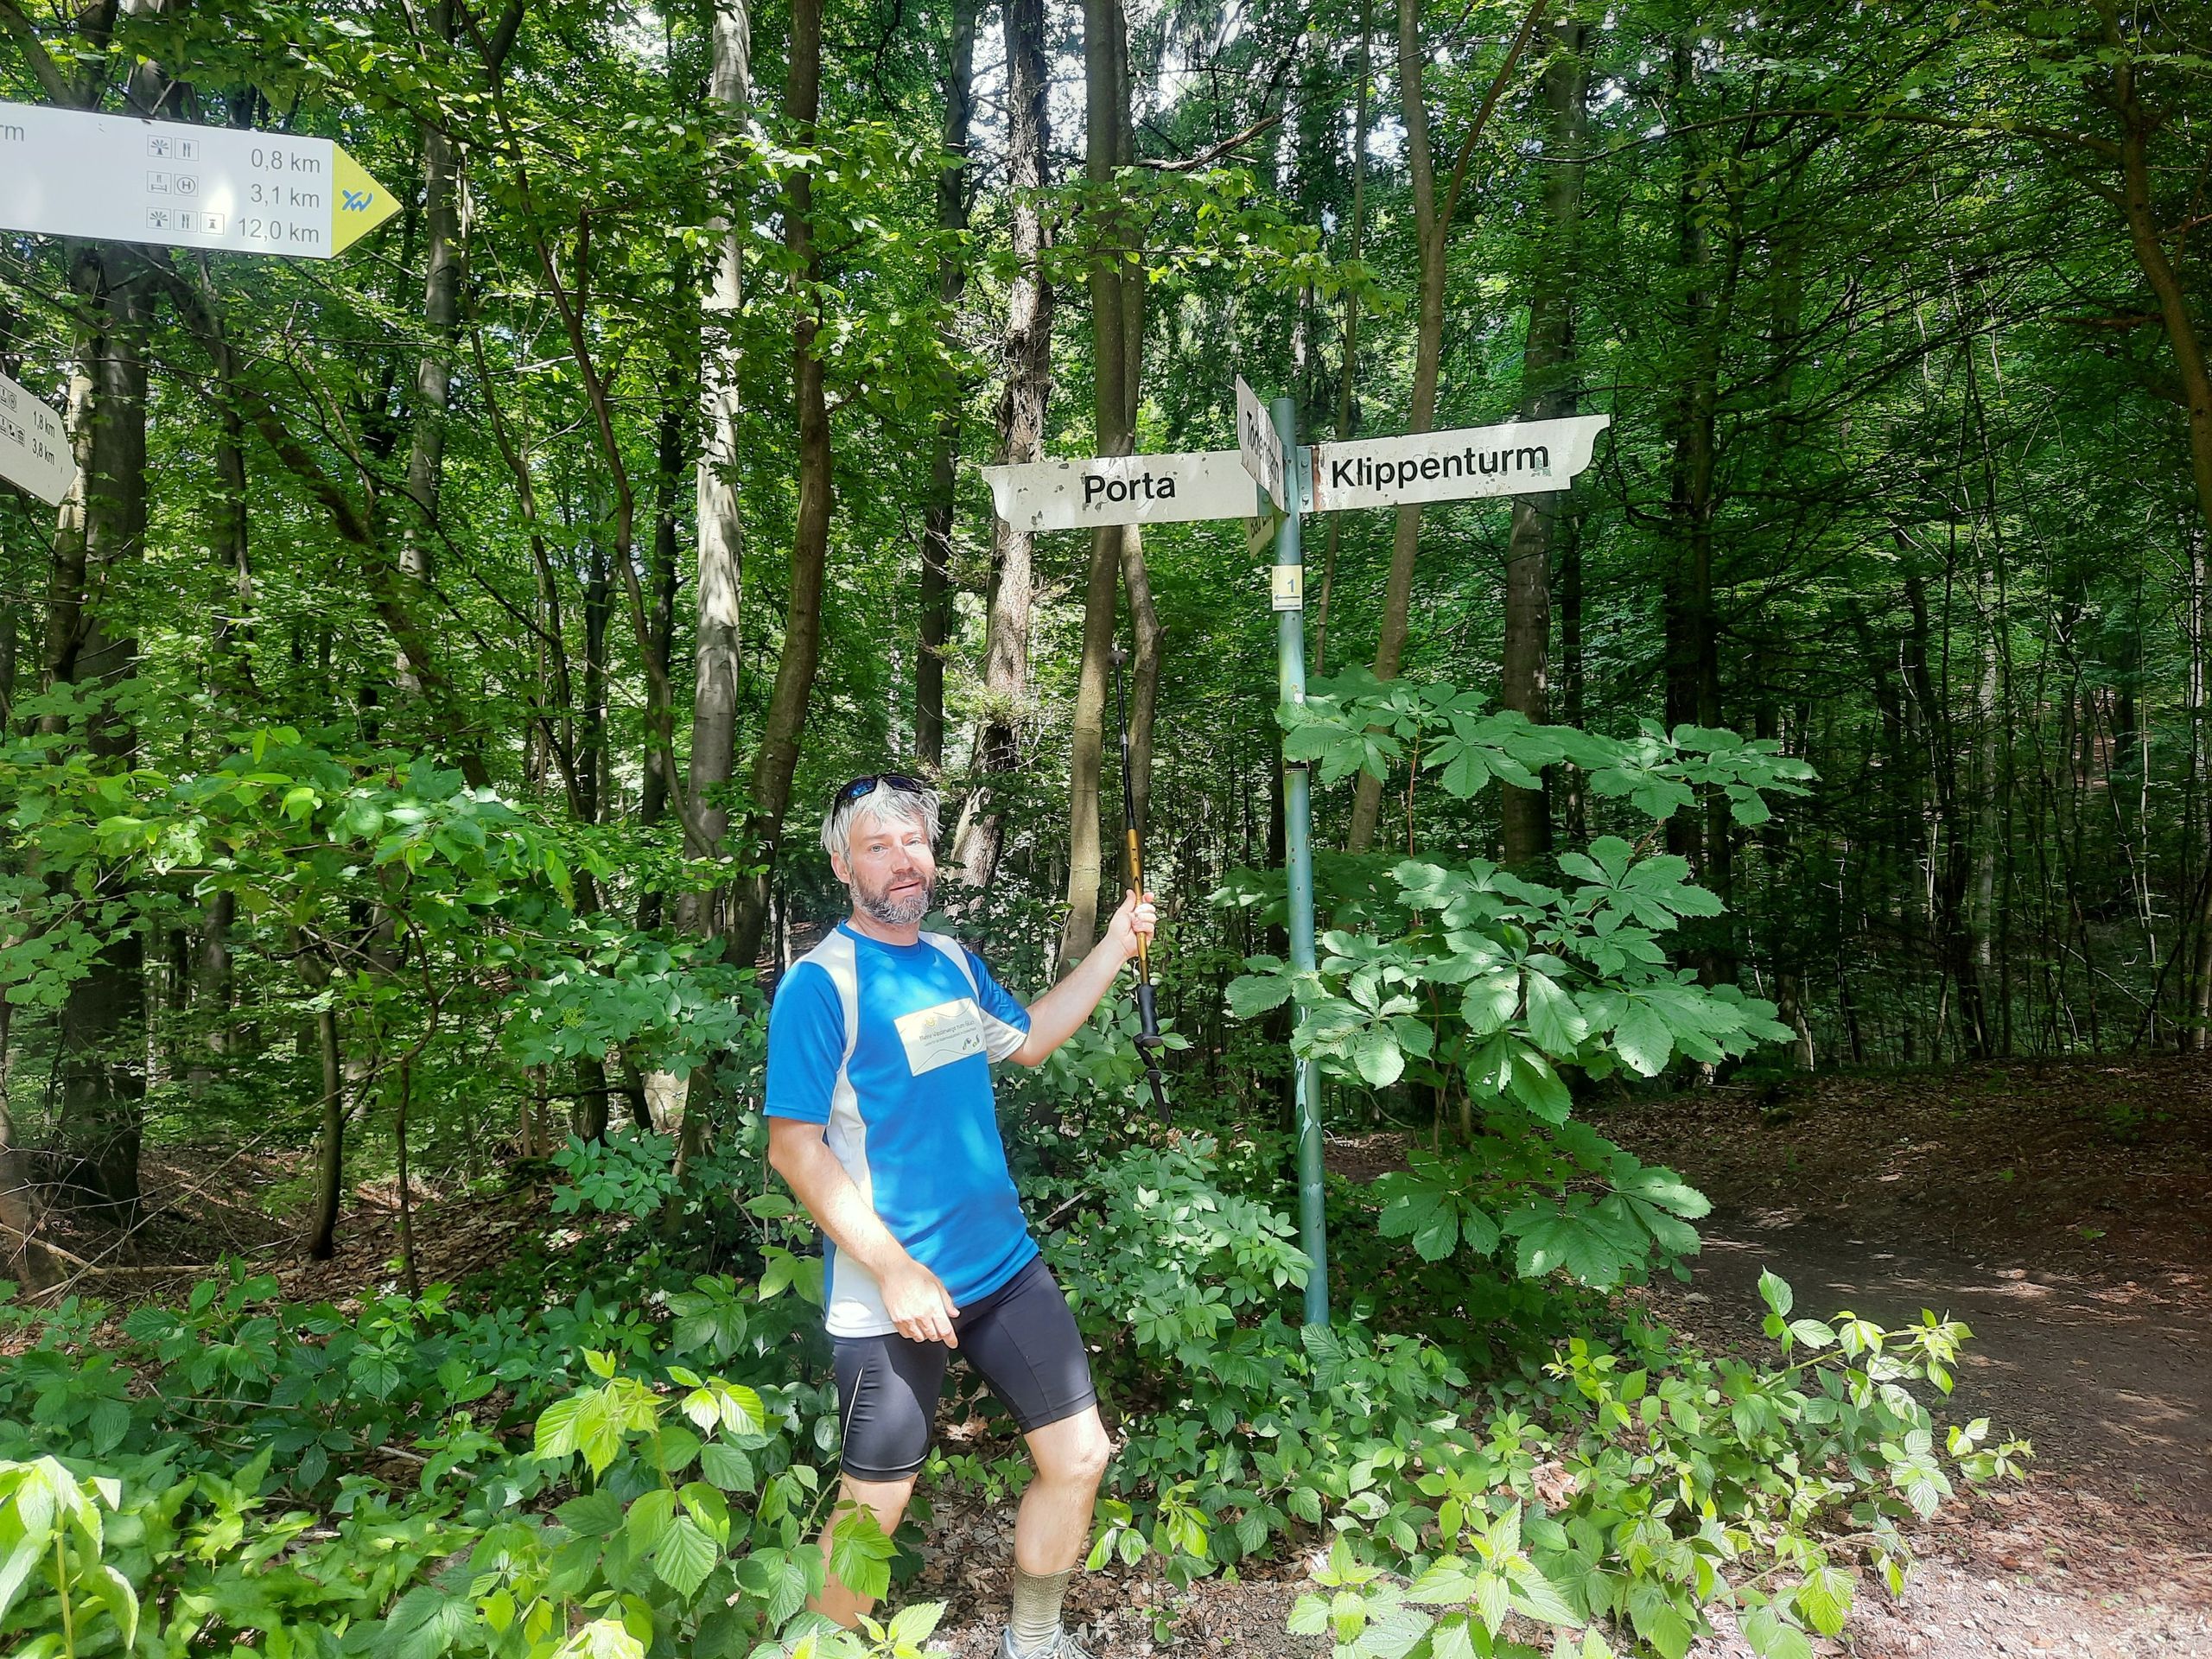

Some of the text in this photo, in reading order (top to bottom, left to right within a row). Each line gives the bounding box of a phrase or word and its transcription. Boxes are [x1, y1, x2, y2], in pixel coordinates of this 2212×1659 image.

[251, 149, 321, 174] 0,8 km
[251, 183, 320, 208] 3,1 km
[238, 218, 320, 243] 12,0 km
[33, 410, 55, 438] 1,8 km
[32, 438, 55, 466] 3,8 km
[1332, 445, 1549, 492] Klippenturm
[1084, 472, 1176, 504] Porta
[1287, 578, 1294, 593] 1
